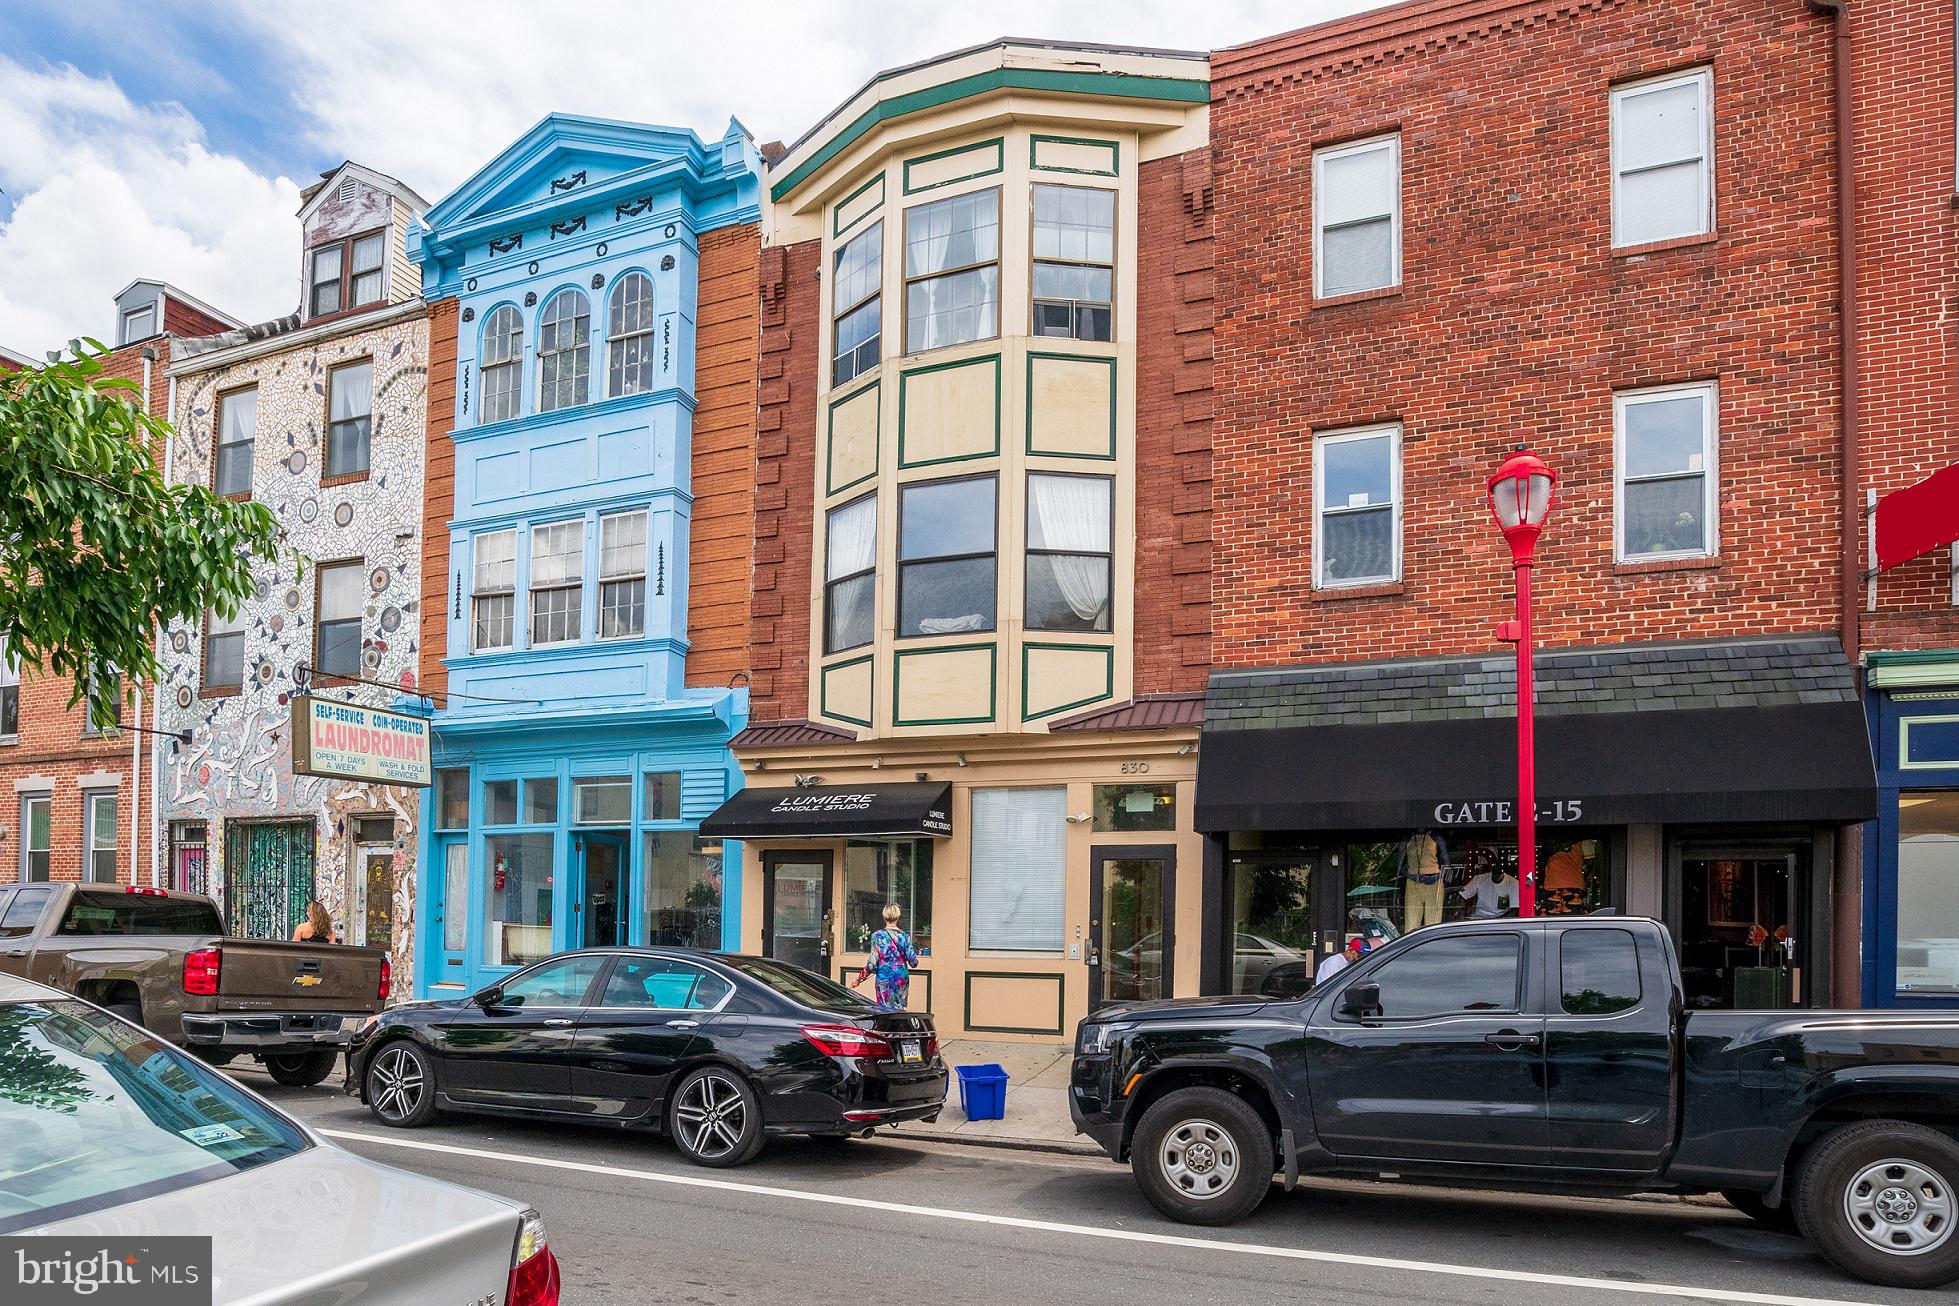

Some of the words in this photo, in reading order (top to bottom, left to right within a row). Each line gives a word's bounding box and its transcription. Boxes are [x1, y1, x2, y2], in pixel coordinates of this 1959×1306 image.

[315, 703, 364, 725] SELF-SERVICE
[372, 714, 424, 736] COIN-OPERATED
[314, 720, 425, 762] LAUNDROMAT
[315, 751, 336, 762] OPEN
[340, 755, 345, 763] 7
[347, 756, 366, 766] DAYS
[326, 761, 332, 770] A
[335, 762, 357, 773] WEEK
[379, 760, 398, 770] WASH
[407, 764, 425, 773] FOLD
[1121, 761, 1150, 775] 830
[386, 768, 419, 780] SERVICES
[779, 793, 877, 806] LUMIERE
[771, 805, 822, 813] CANDLE
[823, 803, 870, 811] STUDIO
[1434, 801, 1511, 824] GATE
